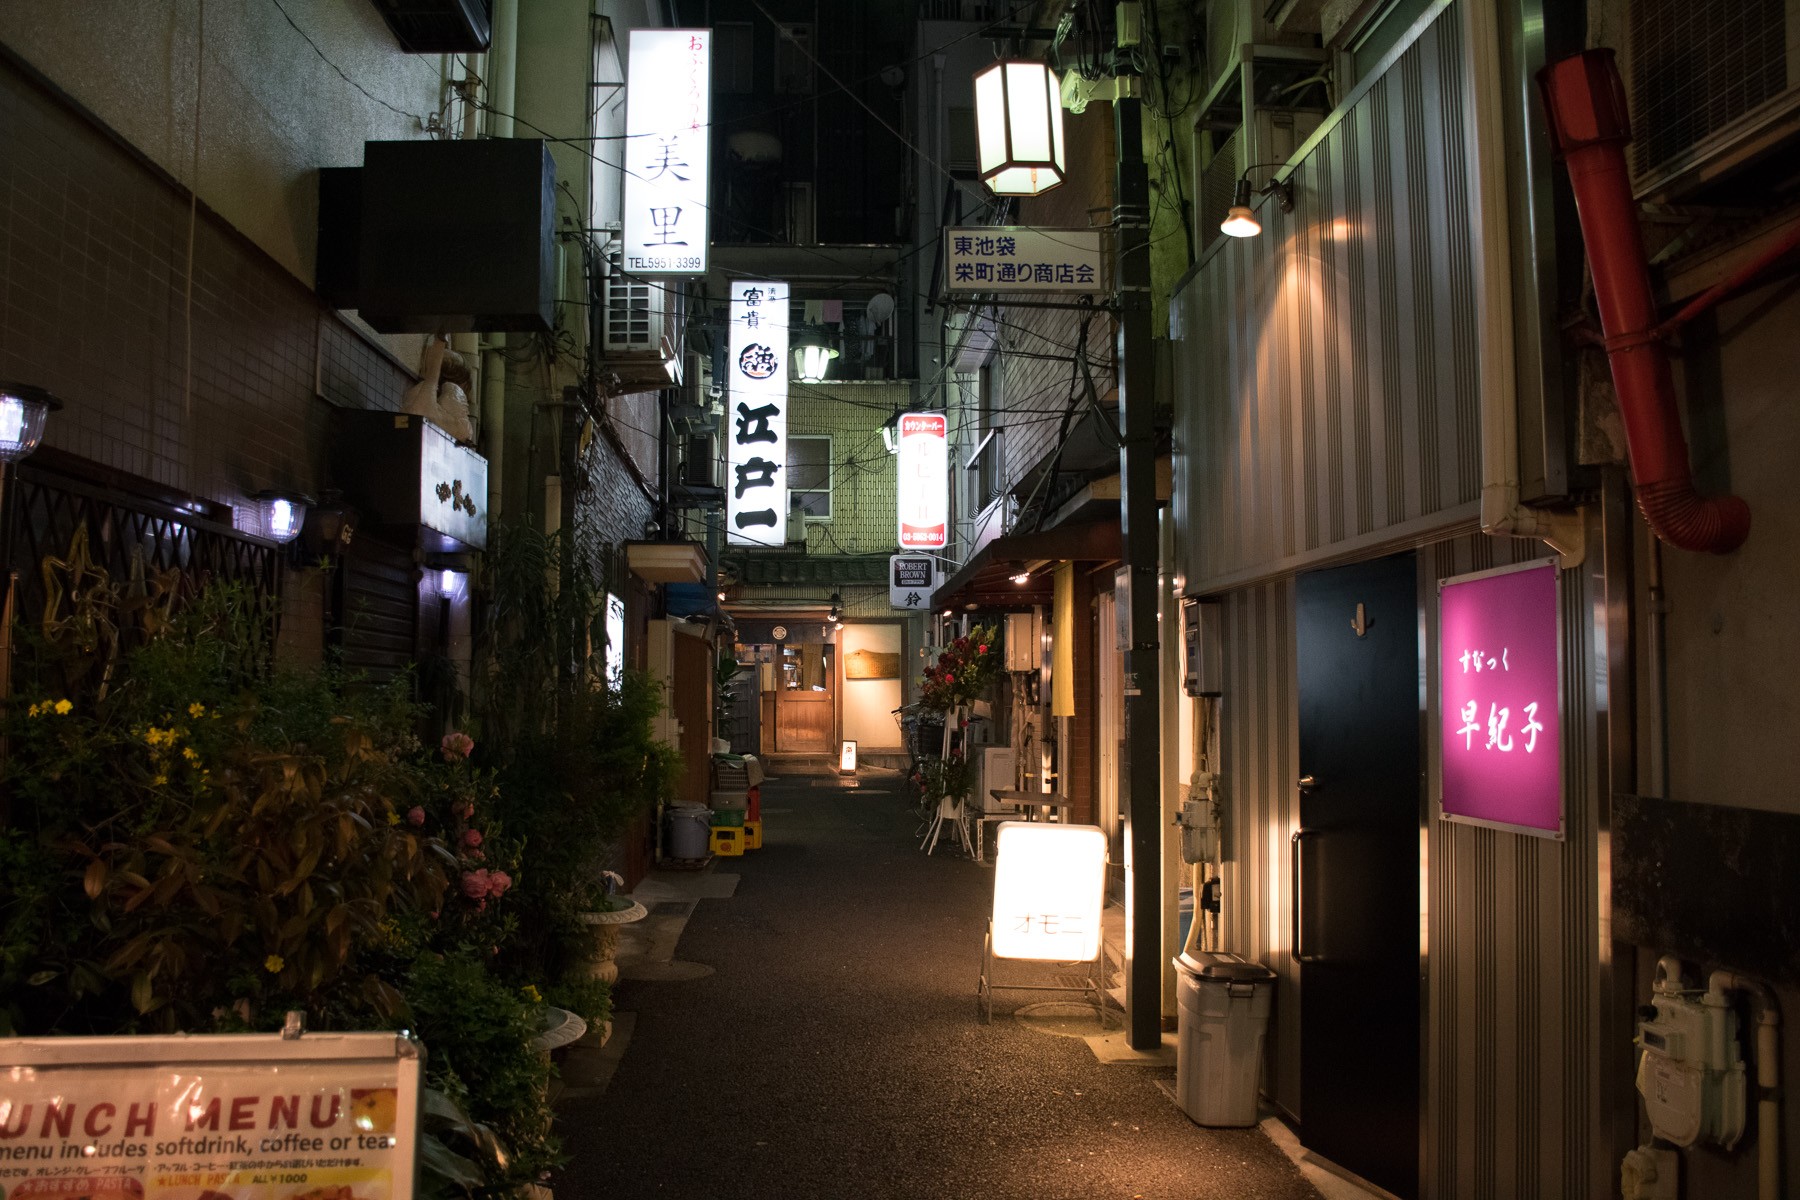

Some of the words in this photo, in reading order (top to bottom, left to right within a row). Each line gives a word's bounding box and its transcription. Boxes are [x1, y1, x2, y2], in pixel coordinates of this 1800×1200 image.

[643, 135, 690, 247] 美里
[953, 236, 1016, 257] 東池袋
[955, 262, 1095, 284] 栄町通り商店会
[735, 402, 780, 530] 江戸一
[899, 562, 928, 571] ROBERT
[899, 570, 927, 579] BROWN
[904, 591, 922, 607] 鈴
[1458, 647, 1510, 674] すなっく
[1456, 699, 1543, 753] 早紀子
[1013, 912, 1083, 935] オモニ
[0, 1101, 158, 1139] UNCH
[184, 1094, 341, 1132] MENU
[155, 1136, 252, 1156] softdrink,
[259, 1135, 323, 1153] coffee
[329, 1136, 352, 1151] or
[207, 1173, 241, 1185] PASA
